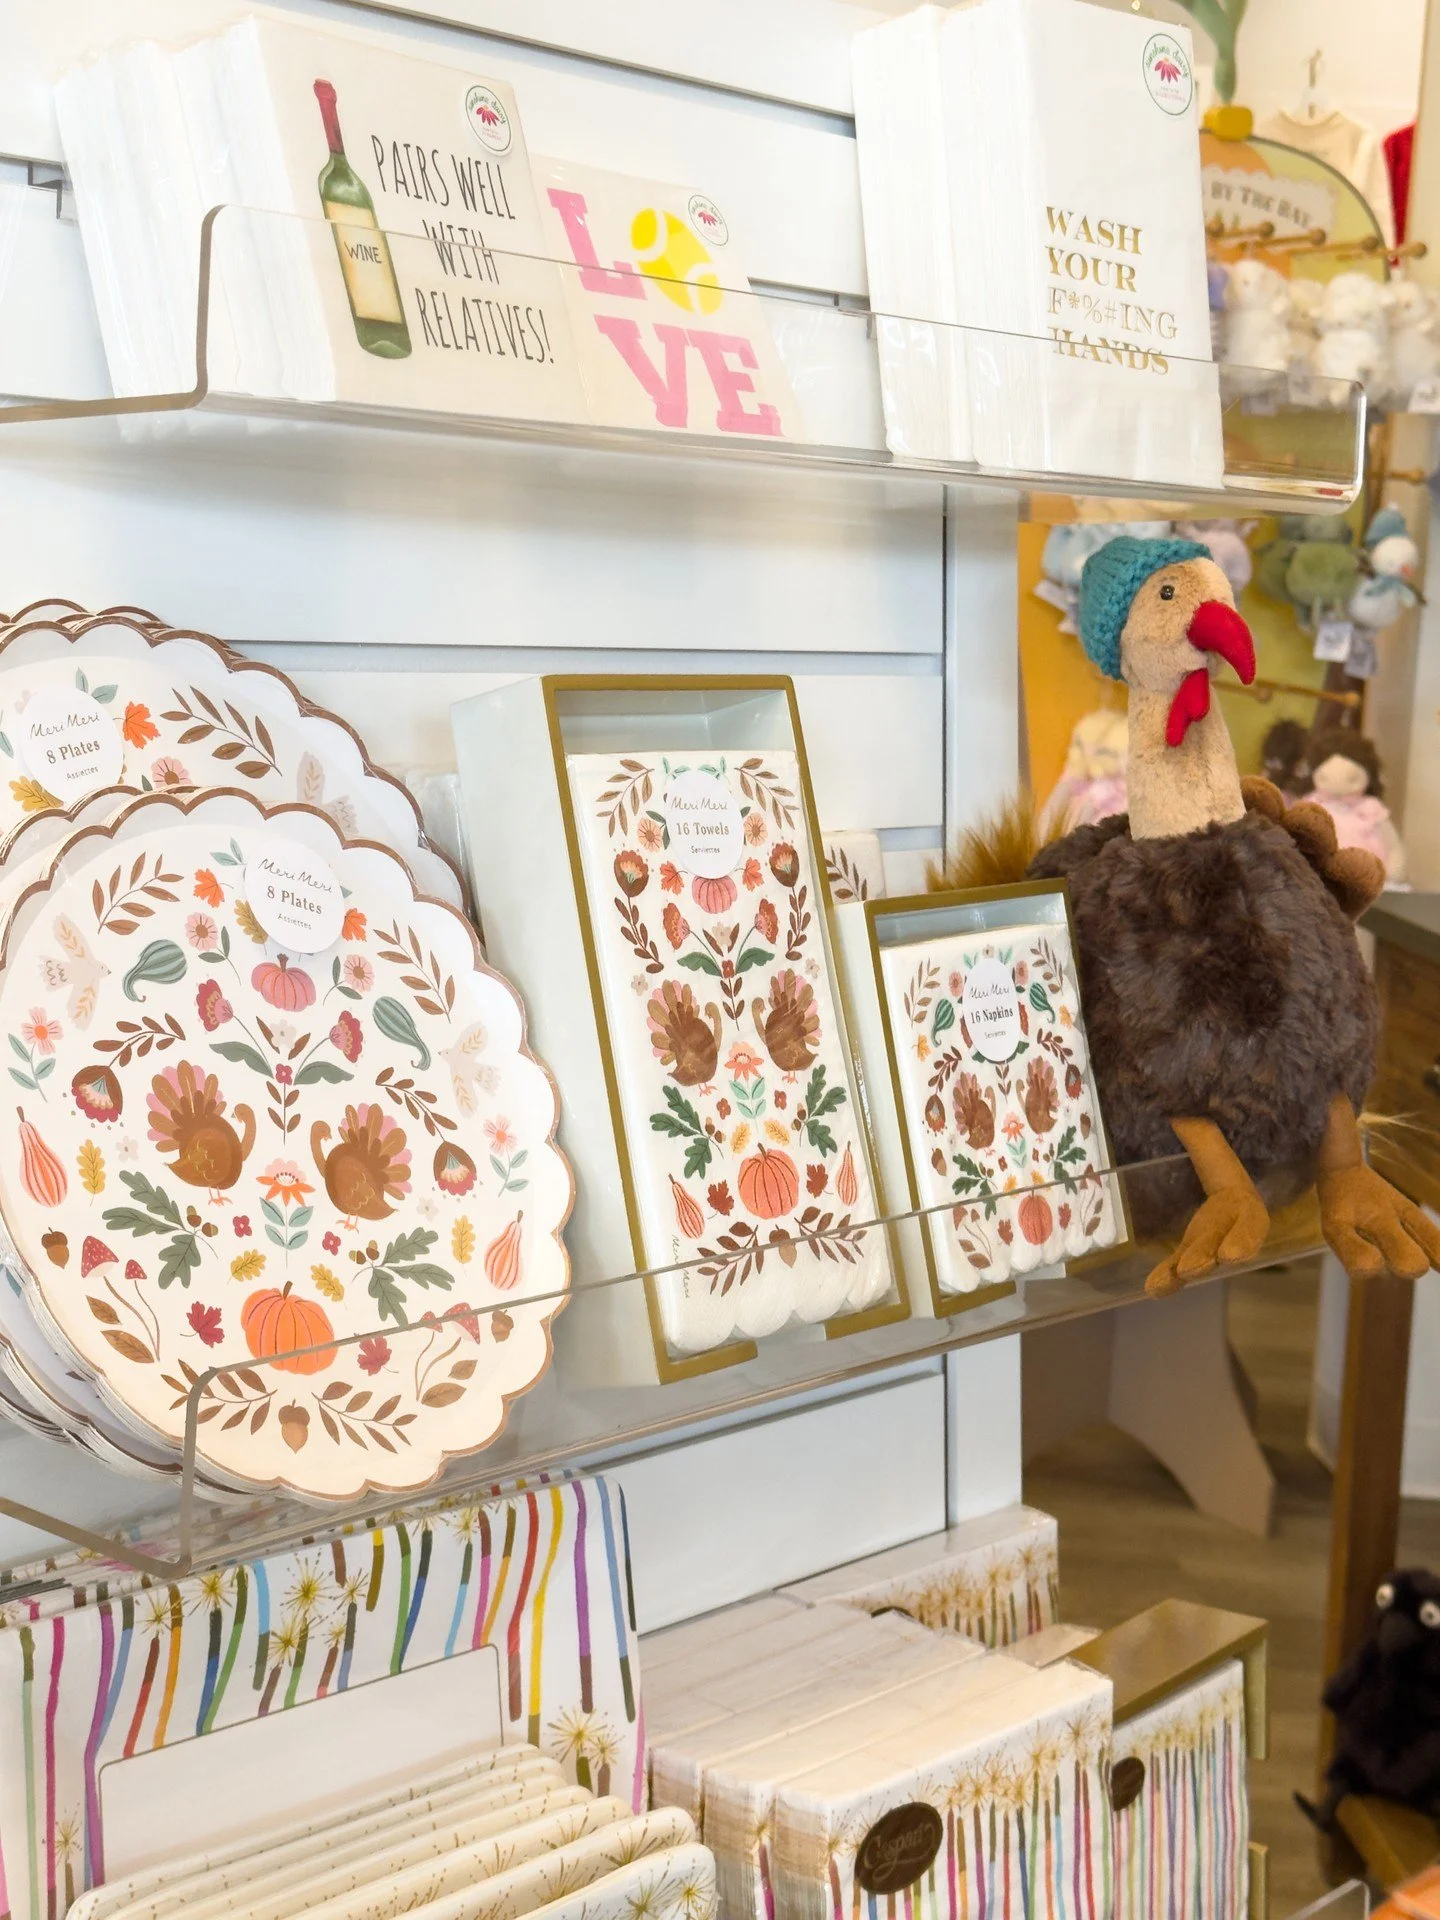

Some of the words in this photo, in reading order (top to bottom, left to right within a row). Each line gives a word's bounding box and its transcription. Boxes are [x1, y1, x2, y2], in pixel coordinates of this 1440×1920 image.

[371, 134, 452, 208] PAIRS
[450, 154, 516, 220] WELL
[1045, 206, 1143, 255] WASH
[343, 243, 383, 265] WINE
[422, 219, 501, 285] WITH
[1045, 246, 1138, 293] YOUR
[414, 287, 555, 365] RELATIVES!
[1047, 326, 1170, 375] HANDS
[30, 722, 64, 740] Meri
[67, 711, 100, 729] Meri
[46, 749, 57, 765] 8
[59, 739, 101, 761] Plates
[670, 796, 698, 811] Meri
[699, 796, 728, 811] Meri
[676, 822, 690, 835] 16
[693, 822, 729, 836] Towels
[258, 858, 295, 881] Meri
[298, 871, 333, 893] Meri
[266, 885, 275, 899] 8
[281, 889, 322, 914] Plates
[970, 1012, 981, 1024] 16
[982, 1005, 1014, 1022] Napkins
